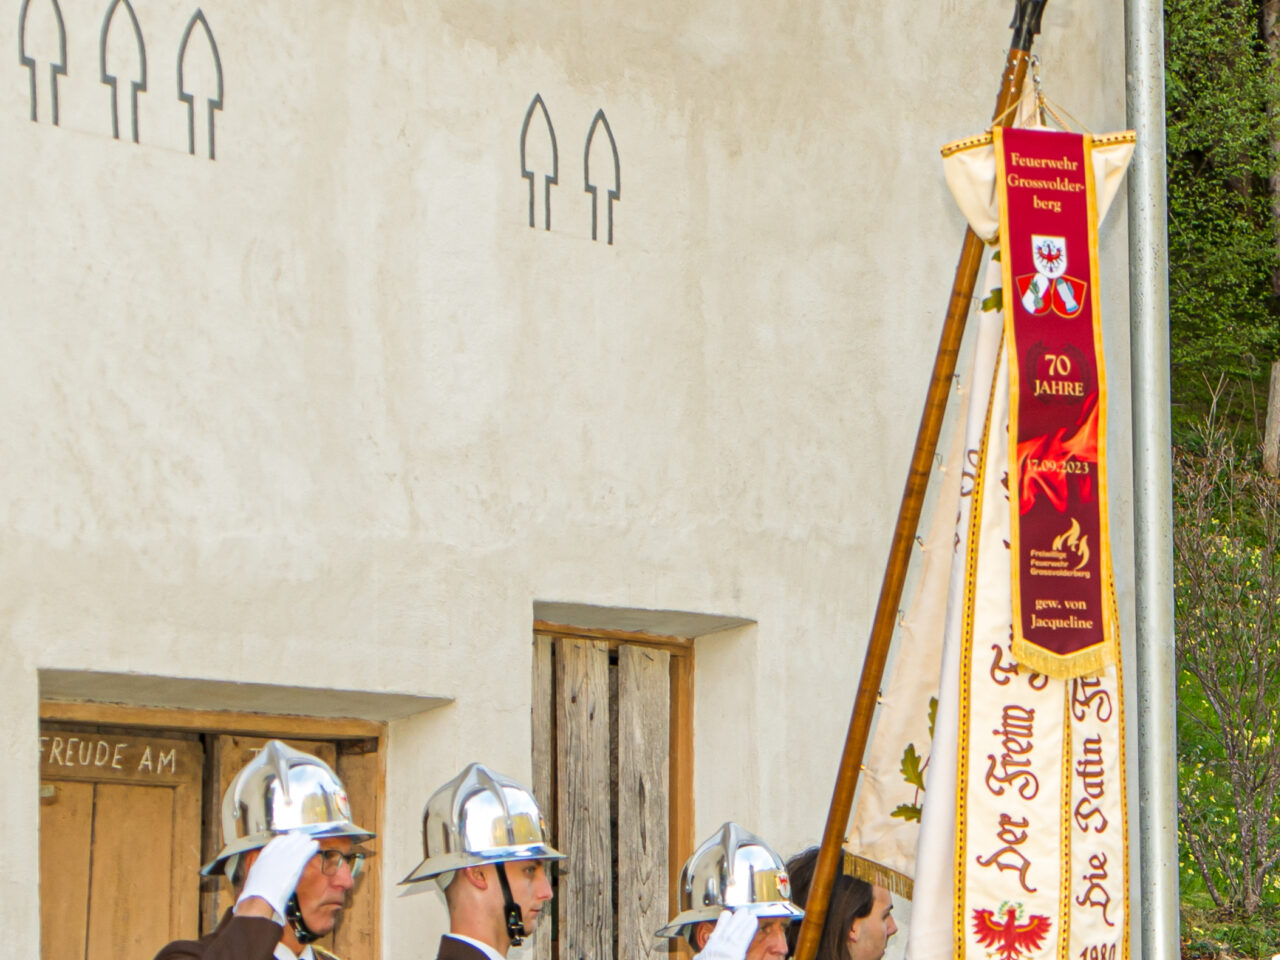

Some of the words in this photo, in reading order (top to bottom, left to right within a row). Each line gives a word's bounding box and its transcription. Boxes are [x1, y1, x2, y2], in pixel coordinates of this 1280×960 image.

[1010, 152, 1078, 171] Feuerwehr
[1007, 173, 1085, 192] Grossvolder-
[1033, 194, 1062, 213] berg
[1044, 354, 1071, 376] 70
[1034, 379, 1084, 397] JAHRE
[1026, 458, 1090, 474] 17.09.2023
[1035, 599, 1061, 611] gew.
[1064, 600, 1087, 610] von
[1031, 613, 1093, 630] Jacqueline
[138, 745, 177, 774] AM
[1074, 733, 1108, 833] Patin
[976, 813, 1037, 893] Der
[1076, 852, 1115, 926] Die
